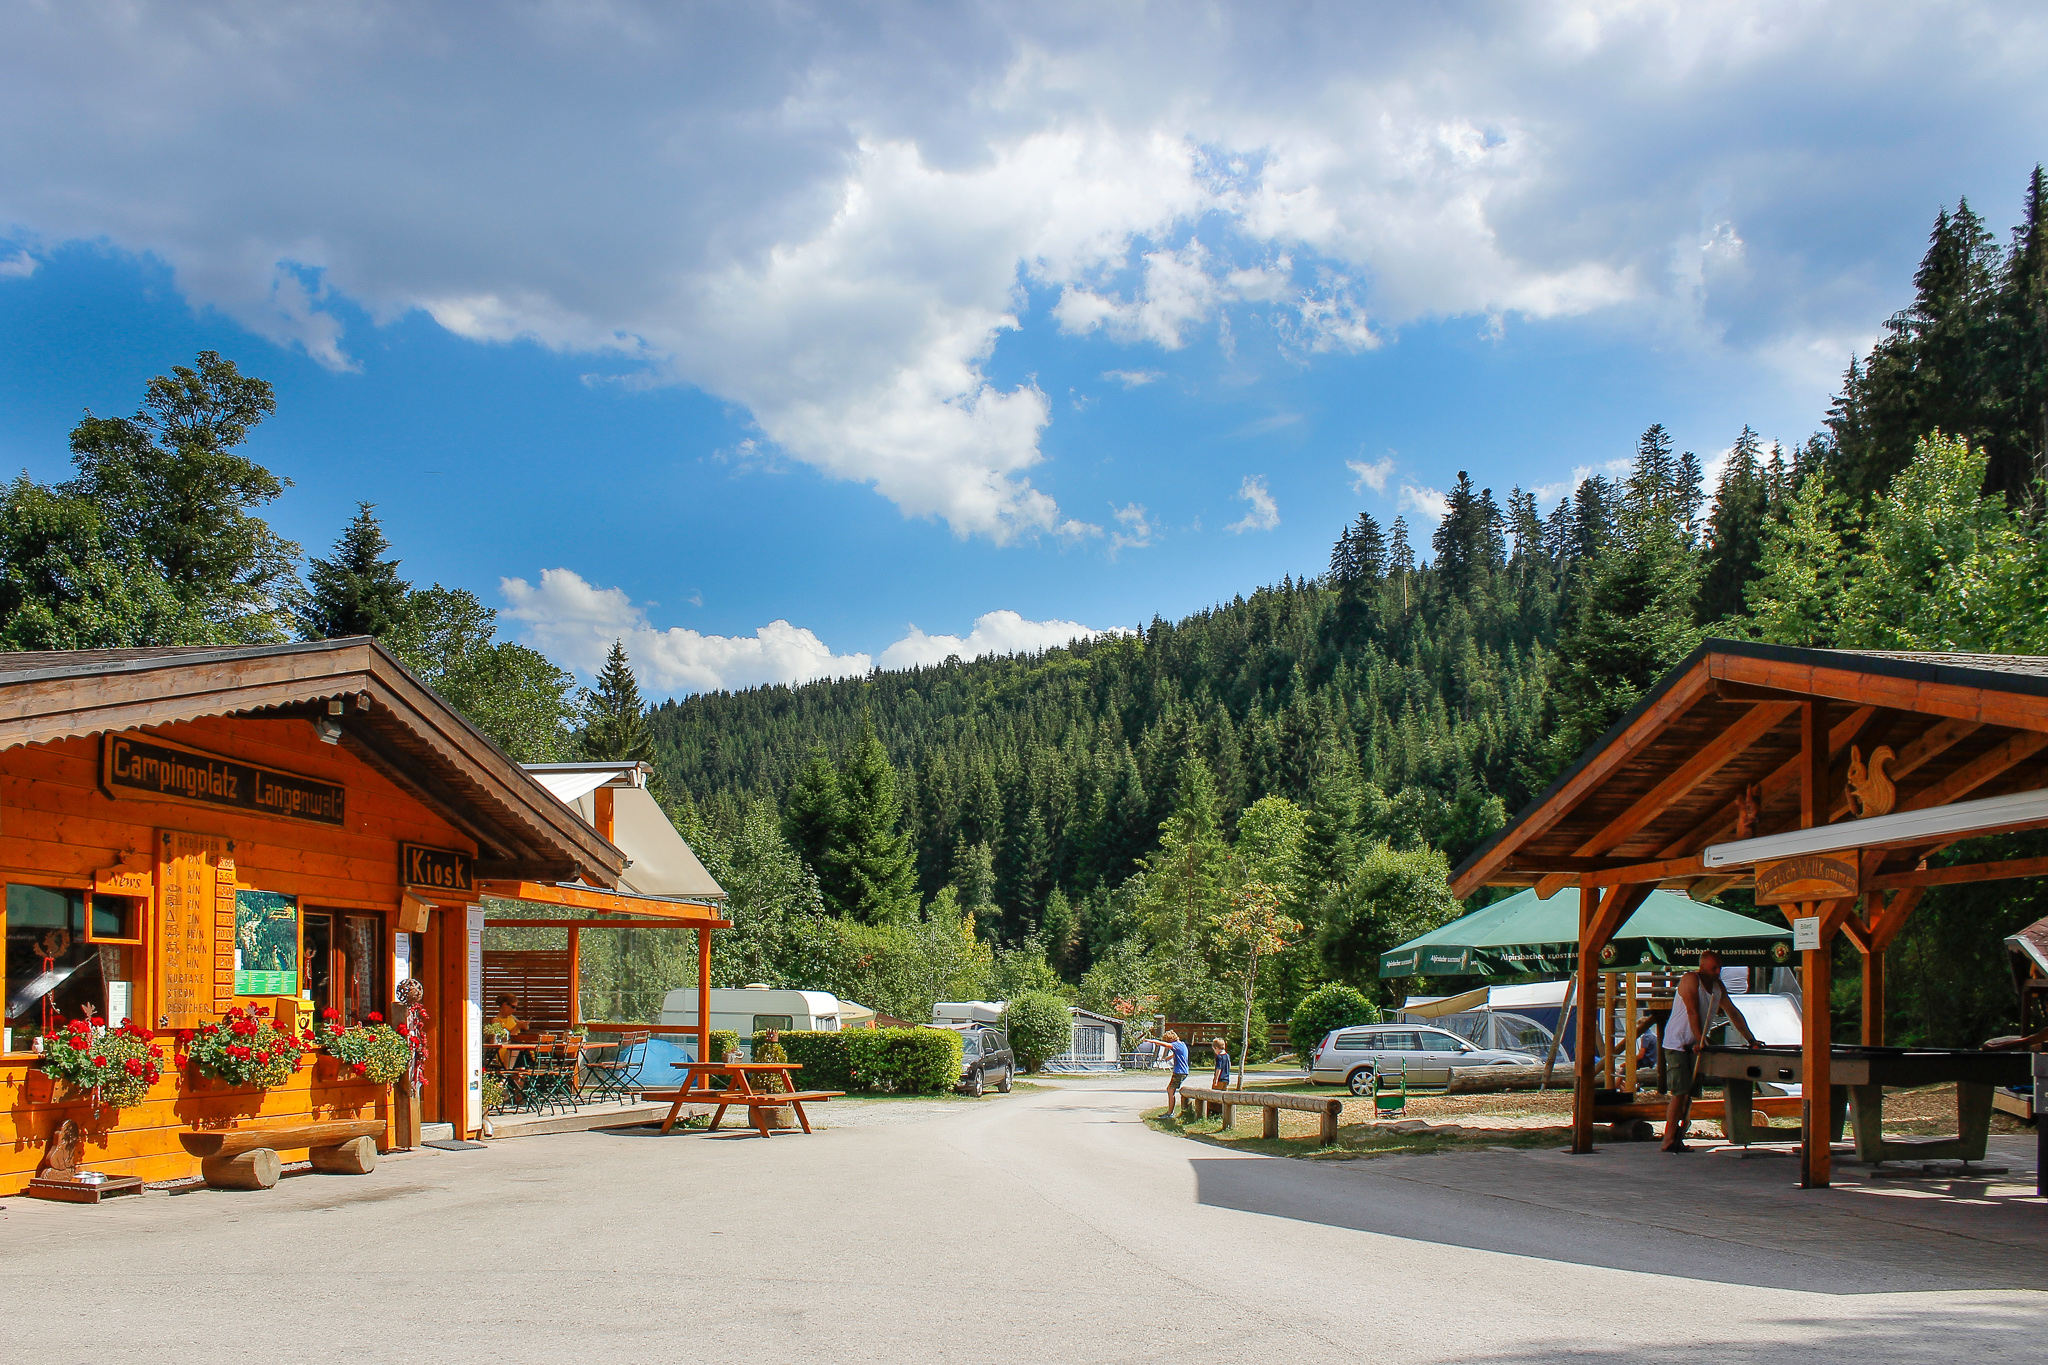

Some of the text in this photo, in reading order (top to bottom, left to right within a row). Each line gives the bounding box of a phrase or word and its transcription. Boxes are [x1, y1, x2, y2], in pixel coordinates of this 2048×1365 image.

[114, 741, 344, 819] Campingplatz Langenwald
[412, 849, 466, 888] Kiosk
[108, 871, 141, 889] News
[1756, 858, 1857, 897] Herzlich Willkommen
[1500, 952, 1545, 963] Alpirsbacher
[1721, 948, 1766, 956] KLOSTERBRÄU
[167, 974, 205, 984] KURTAXE
[167, 988, 195, 999] STROM
[167, 1002, 208, 1014] BESUCHER
